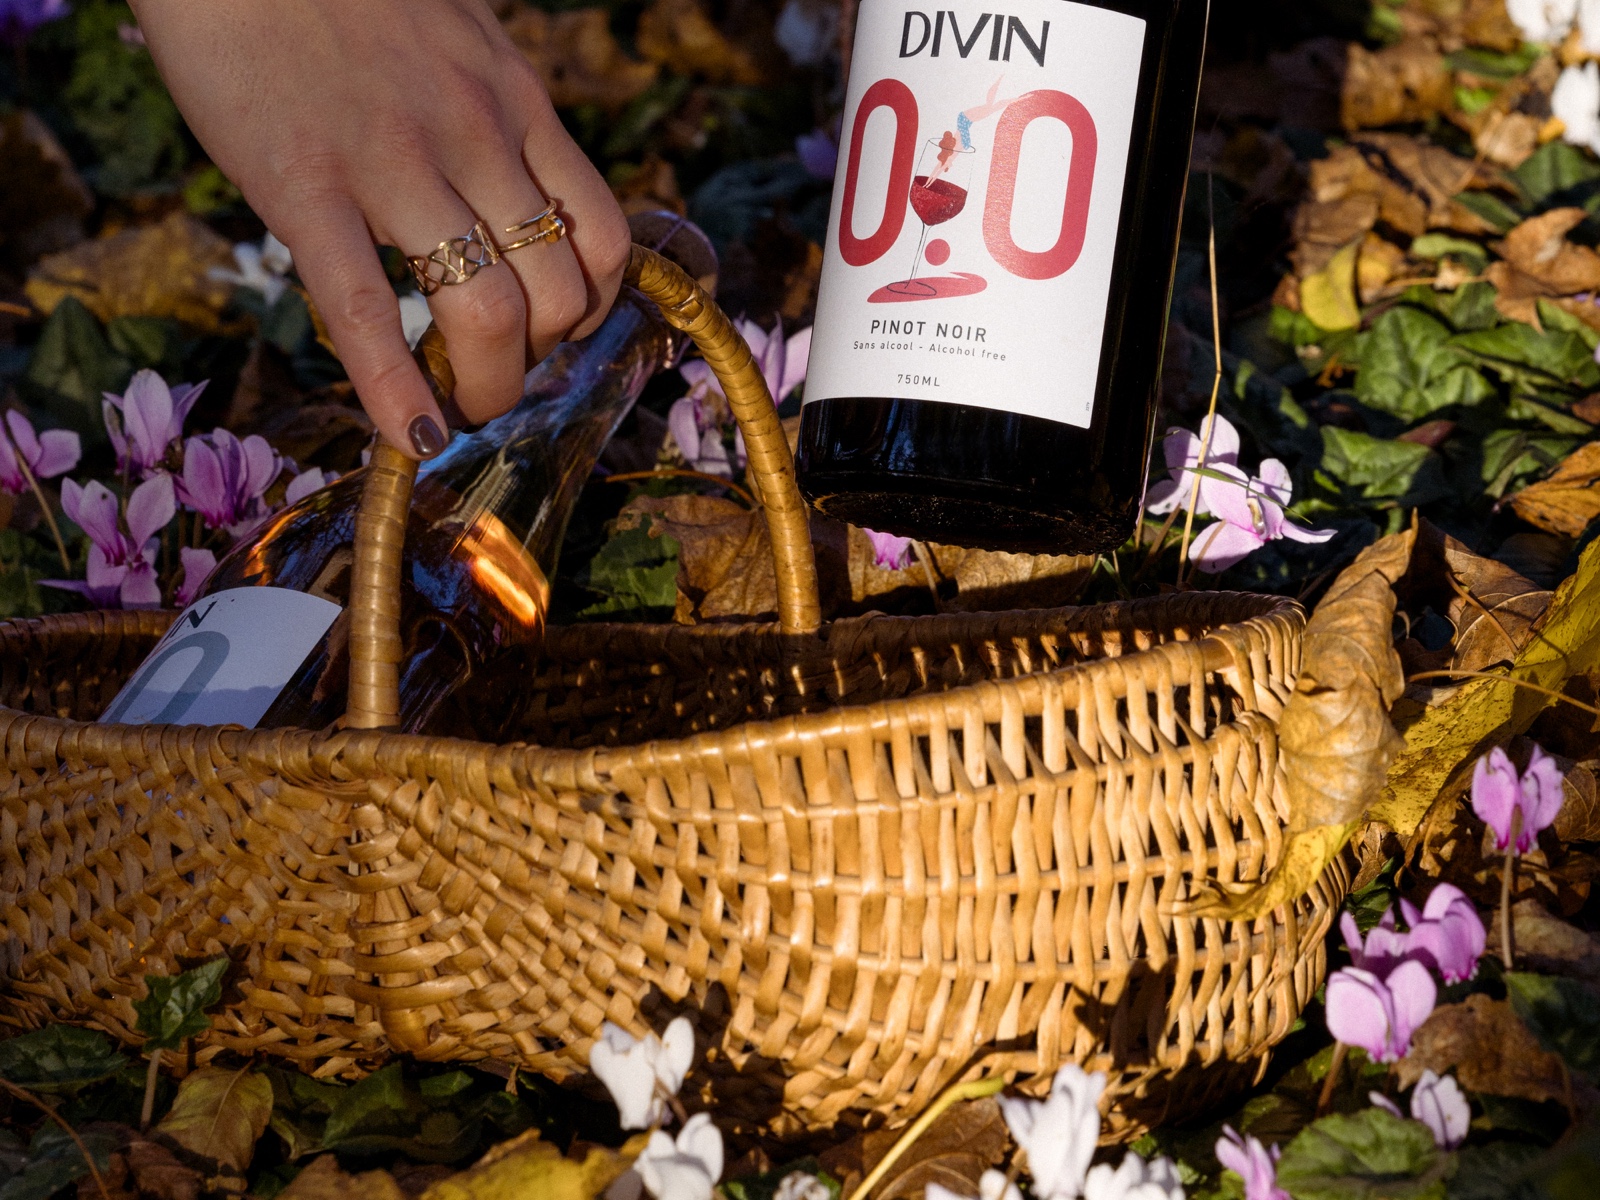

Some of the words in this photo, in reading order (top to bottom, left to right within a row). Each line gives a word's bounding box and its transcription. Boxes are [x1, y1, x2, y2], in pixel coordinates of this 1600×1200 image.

[898, 10, 1051, 68] DIVIN
[870, 319, 927, 336] PINOT
[935, 322, 987, 343] NOIR
[853, 340, 876, 350] Sans
[879, 341, 914, 351] alcool
[928, 343, 976, 357] Alcohol
[981, 349, 1007, 362] free
[897, 373, 941, 387] 750ML
